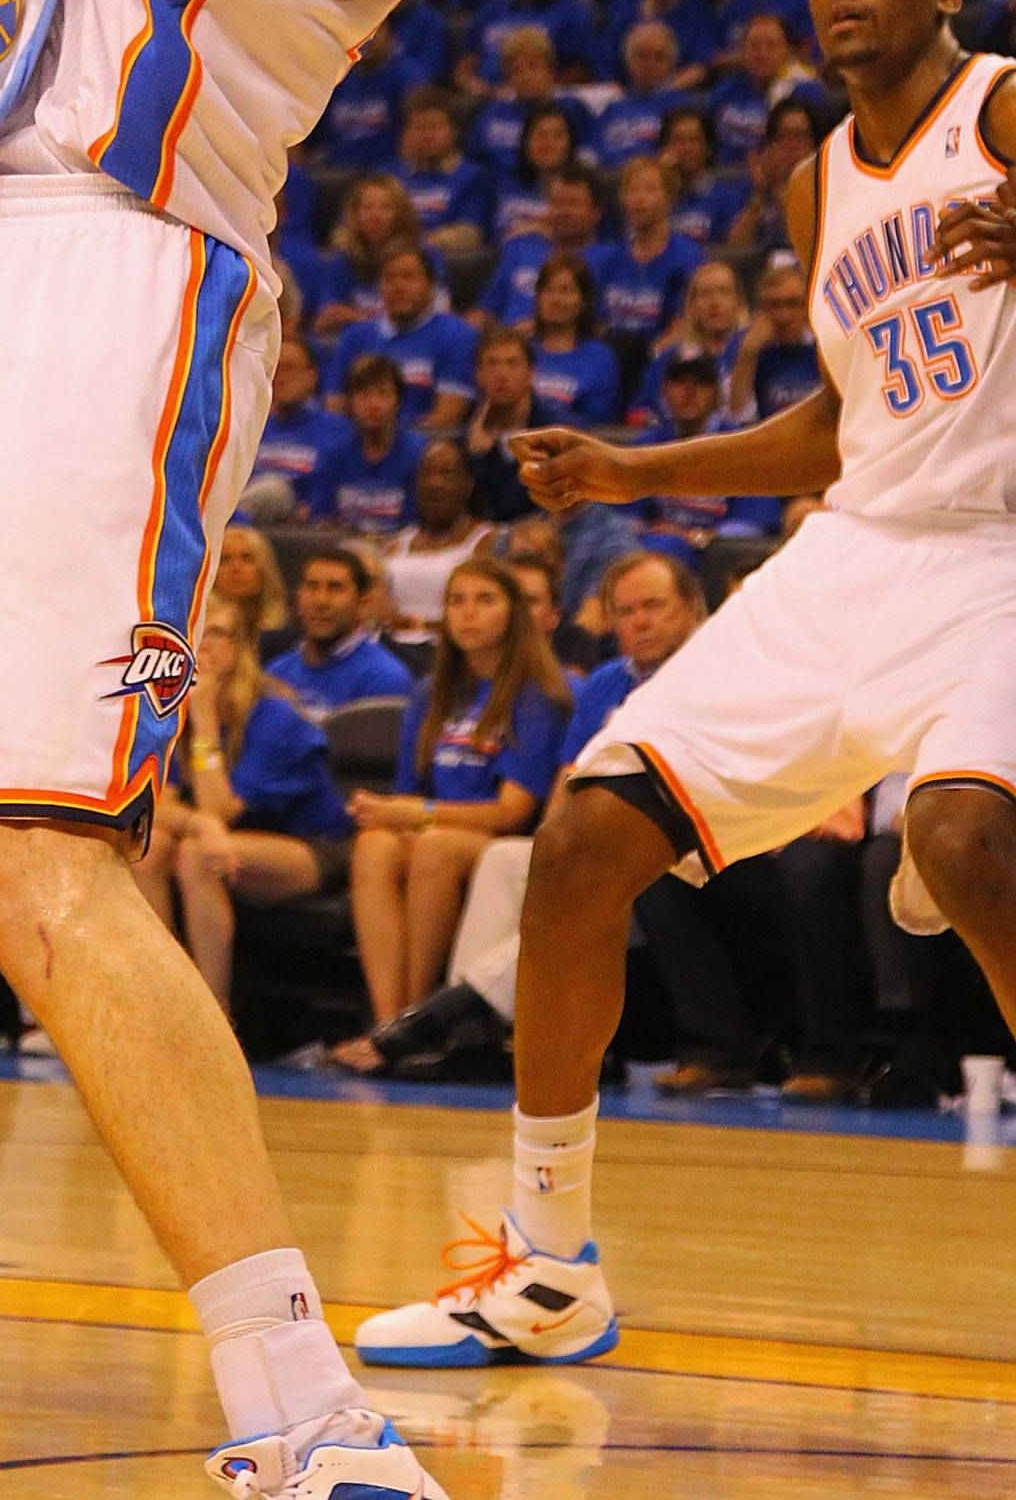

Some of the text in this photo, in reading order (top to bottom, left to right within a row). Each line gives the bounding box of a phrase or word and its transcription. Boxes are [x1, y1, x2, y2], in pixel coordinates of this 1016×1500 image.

[824, 197, 998, 339] THUND
[861, 294, 980, 419] 35
[123, 647, 185, 685] OKC
